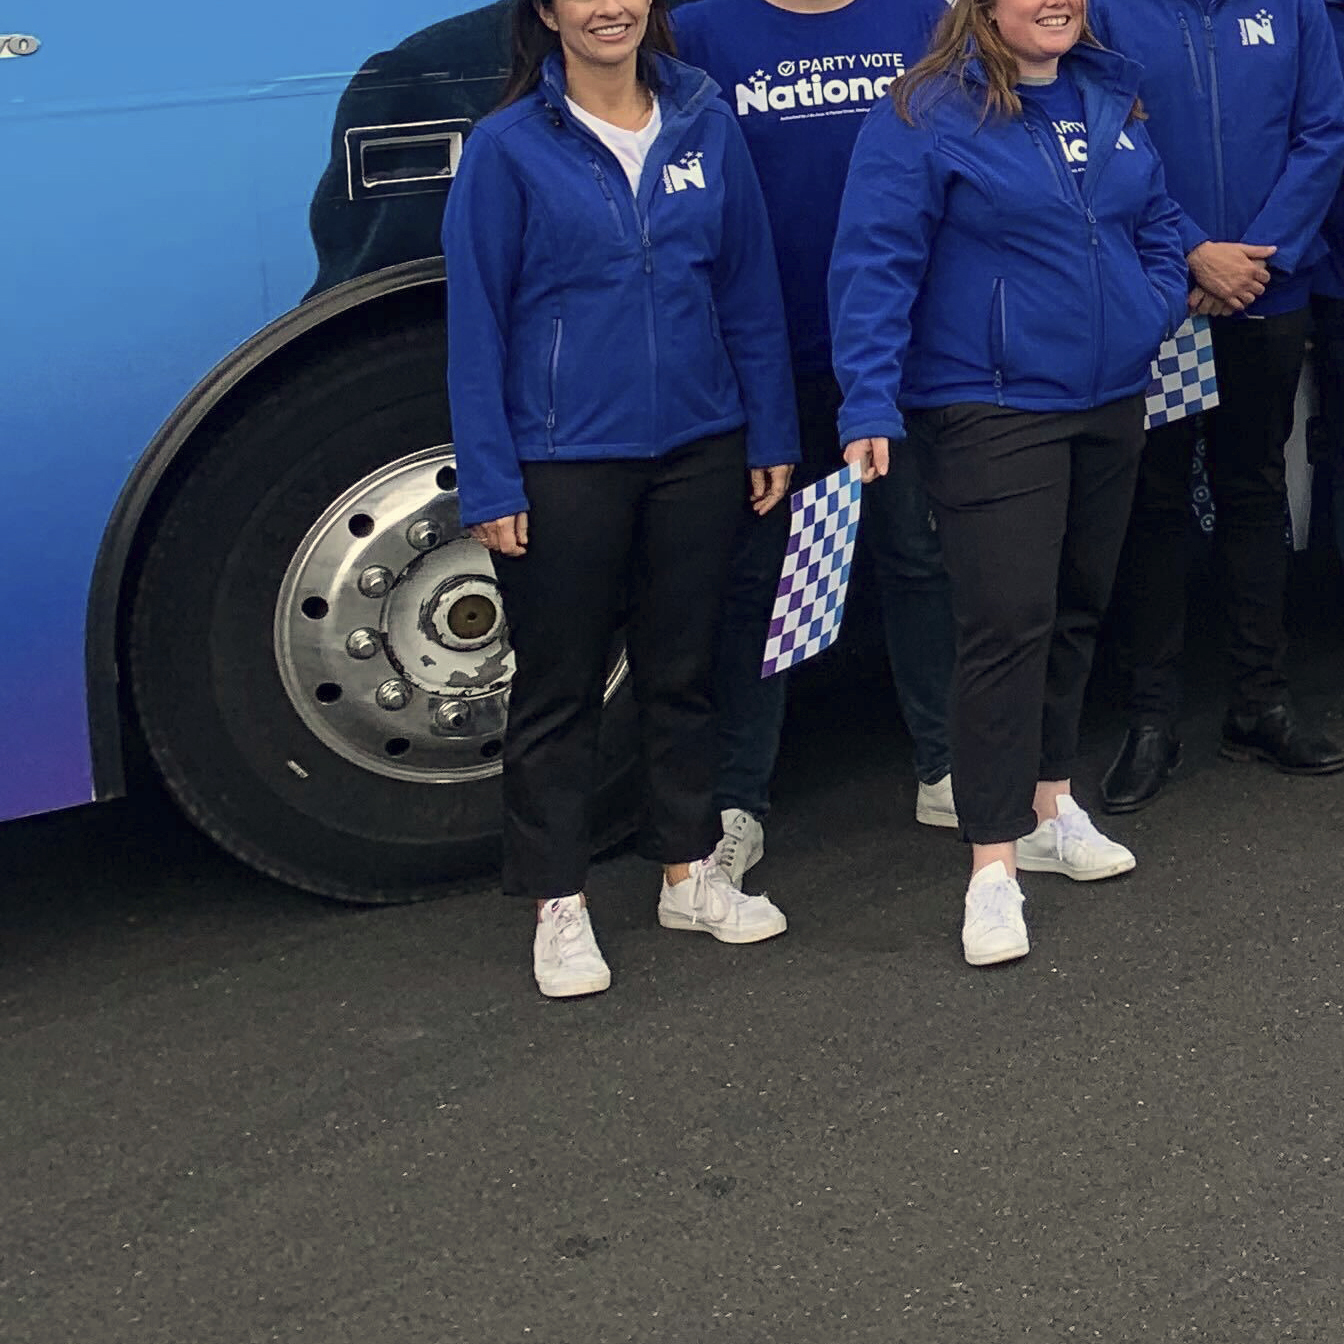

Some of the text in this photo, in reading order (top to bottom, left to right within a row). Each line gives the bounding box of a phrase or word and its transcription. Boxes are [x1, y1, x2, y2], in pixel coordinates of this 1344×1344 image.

[799, 53, 904, 74] PARTY VOTE
[735, 69, 905, 116] Nationa
